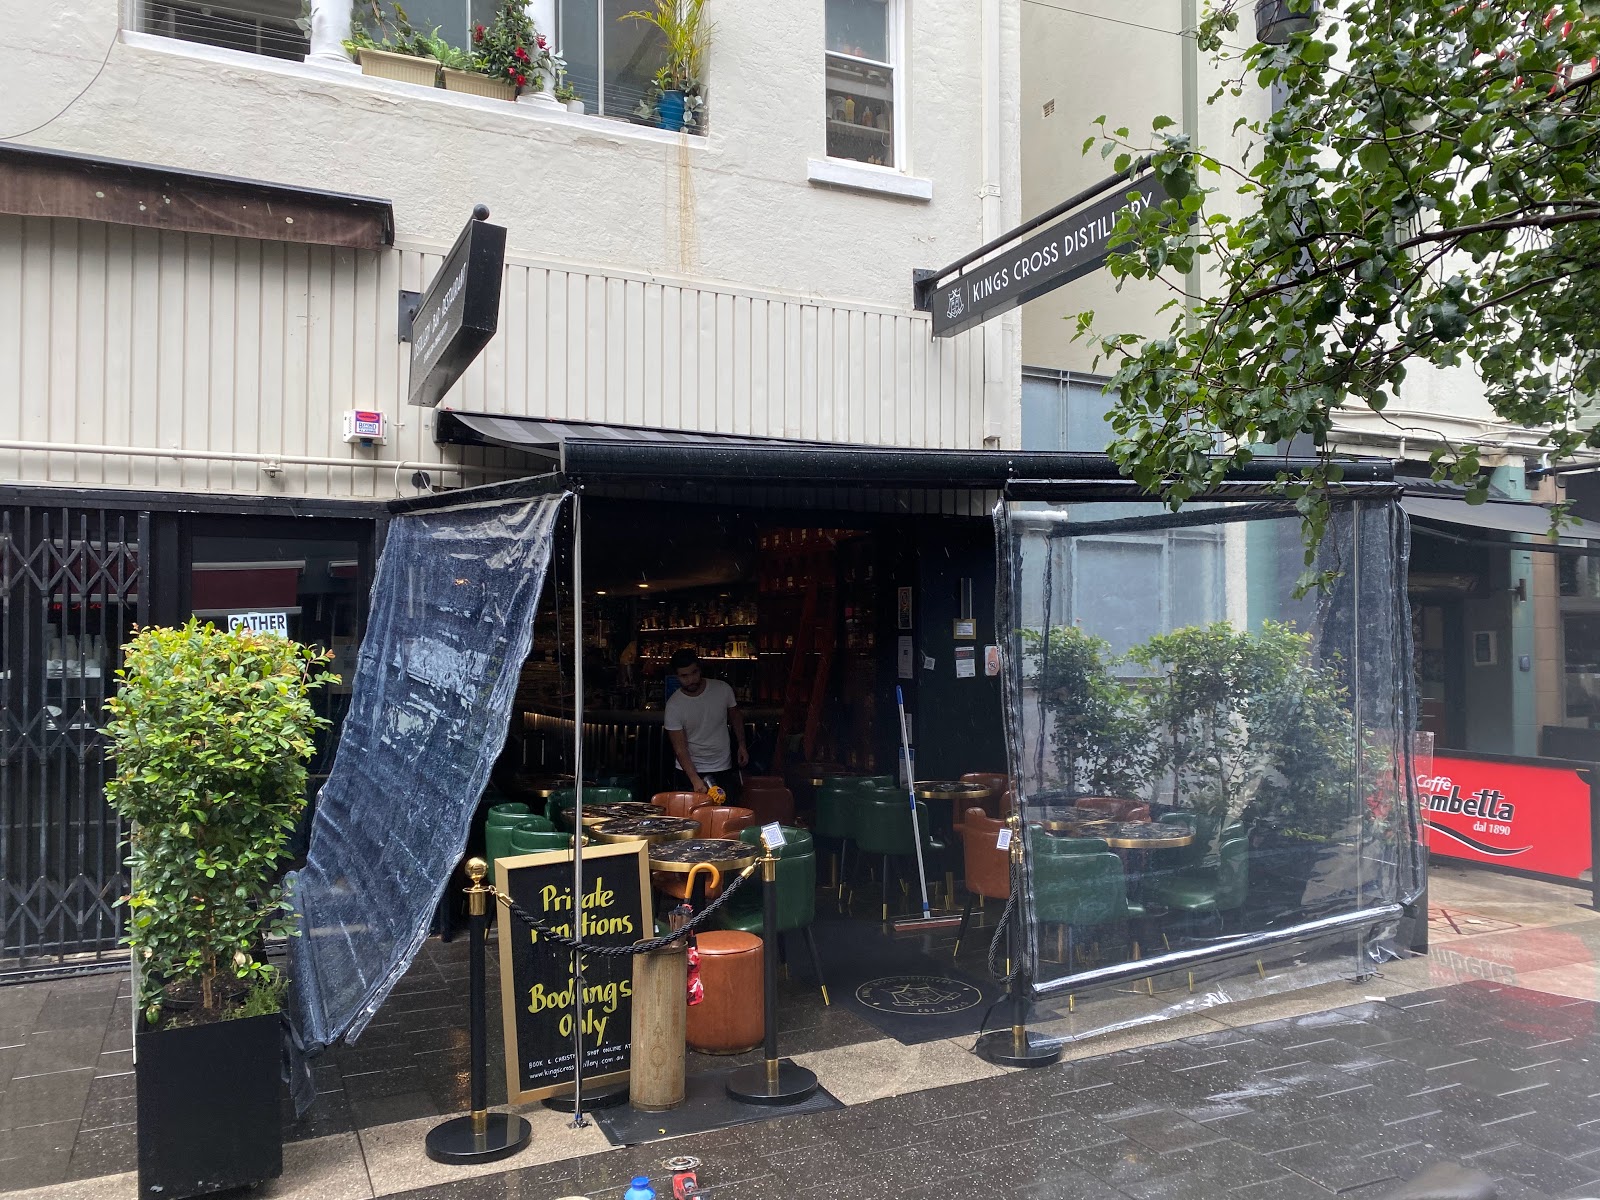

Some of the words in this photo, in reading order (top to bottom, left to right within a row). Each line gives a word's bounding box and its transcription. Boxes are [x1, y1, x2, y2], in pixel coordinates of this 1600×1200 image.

[973, 268, 1009, 302] KINGS
[1013, 242, 1059, 281] CROSS
[1064, 191, 1154, 257] DISTILLRY
[229, 614, 286, 631] GATHER
[1473, 821, 1486, 832] dal
[1489, 823, 1511, 836] 1890
[539, 876, 615, 912] Priate
